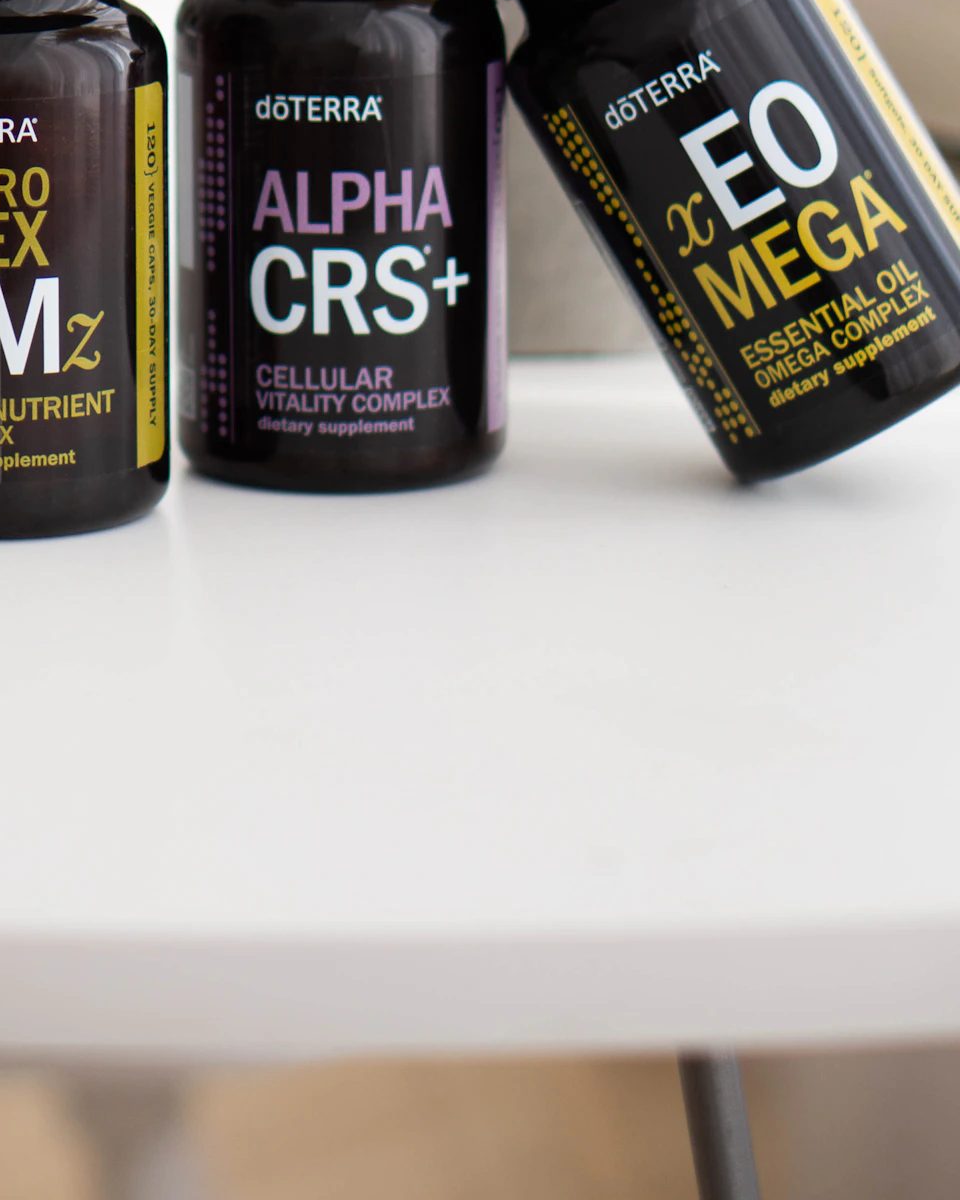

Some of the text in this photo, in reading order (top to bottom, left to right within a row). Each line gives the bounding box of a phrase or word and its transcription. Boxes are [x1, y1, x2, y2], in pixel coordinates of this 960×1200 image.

[148, 182, 156, 240] VEGGIE
[252, 164, 453, 235] ALPHA
[148, 244, 156, 290] CAPS,
[148, 296, 157, 357] 30-DAY
[740, 259, 919, 369] ESSENTIAL OIL
[754, 279, 930, 388] OMEGA COMPLEX
[256, 364, 394, 390] CELLULAR
[769, 305, 937, 408] dietary supplement
[149, 362, 157, 427] SUPPLY
[256, 386, 451, 413] VITALITY COMPLEX
[257, 415, 415, 437] dietary supplement
